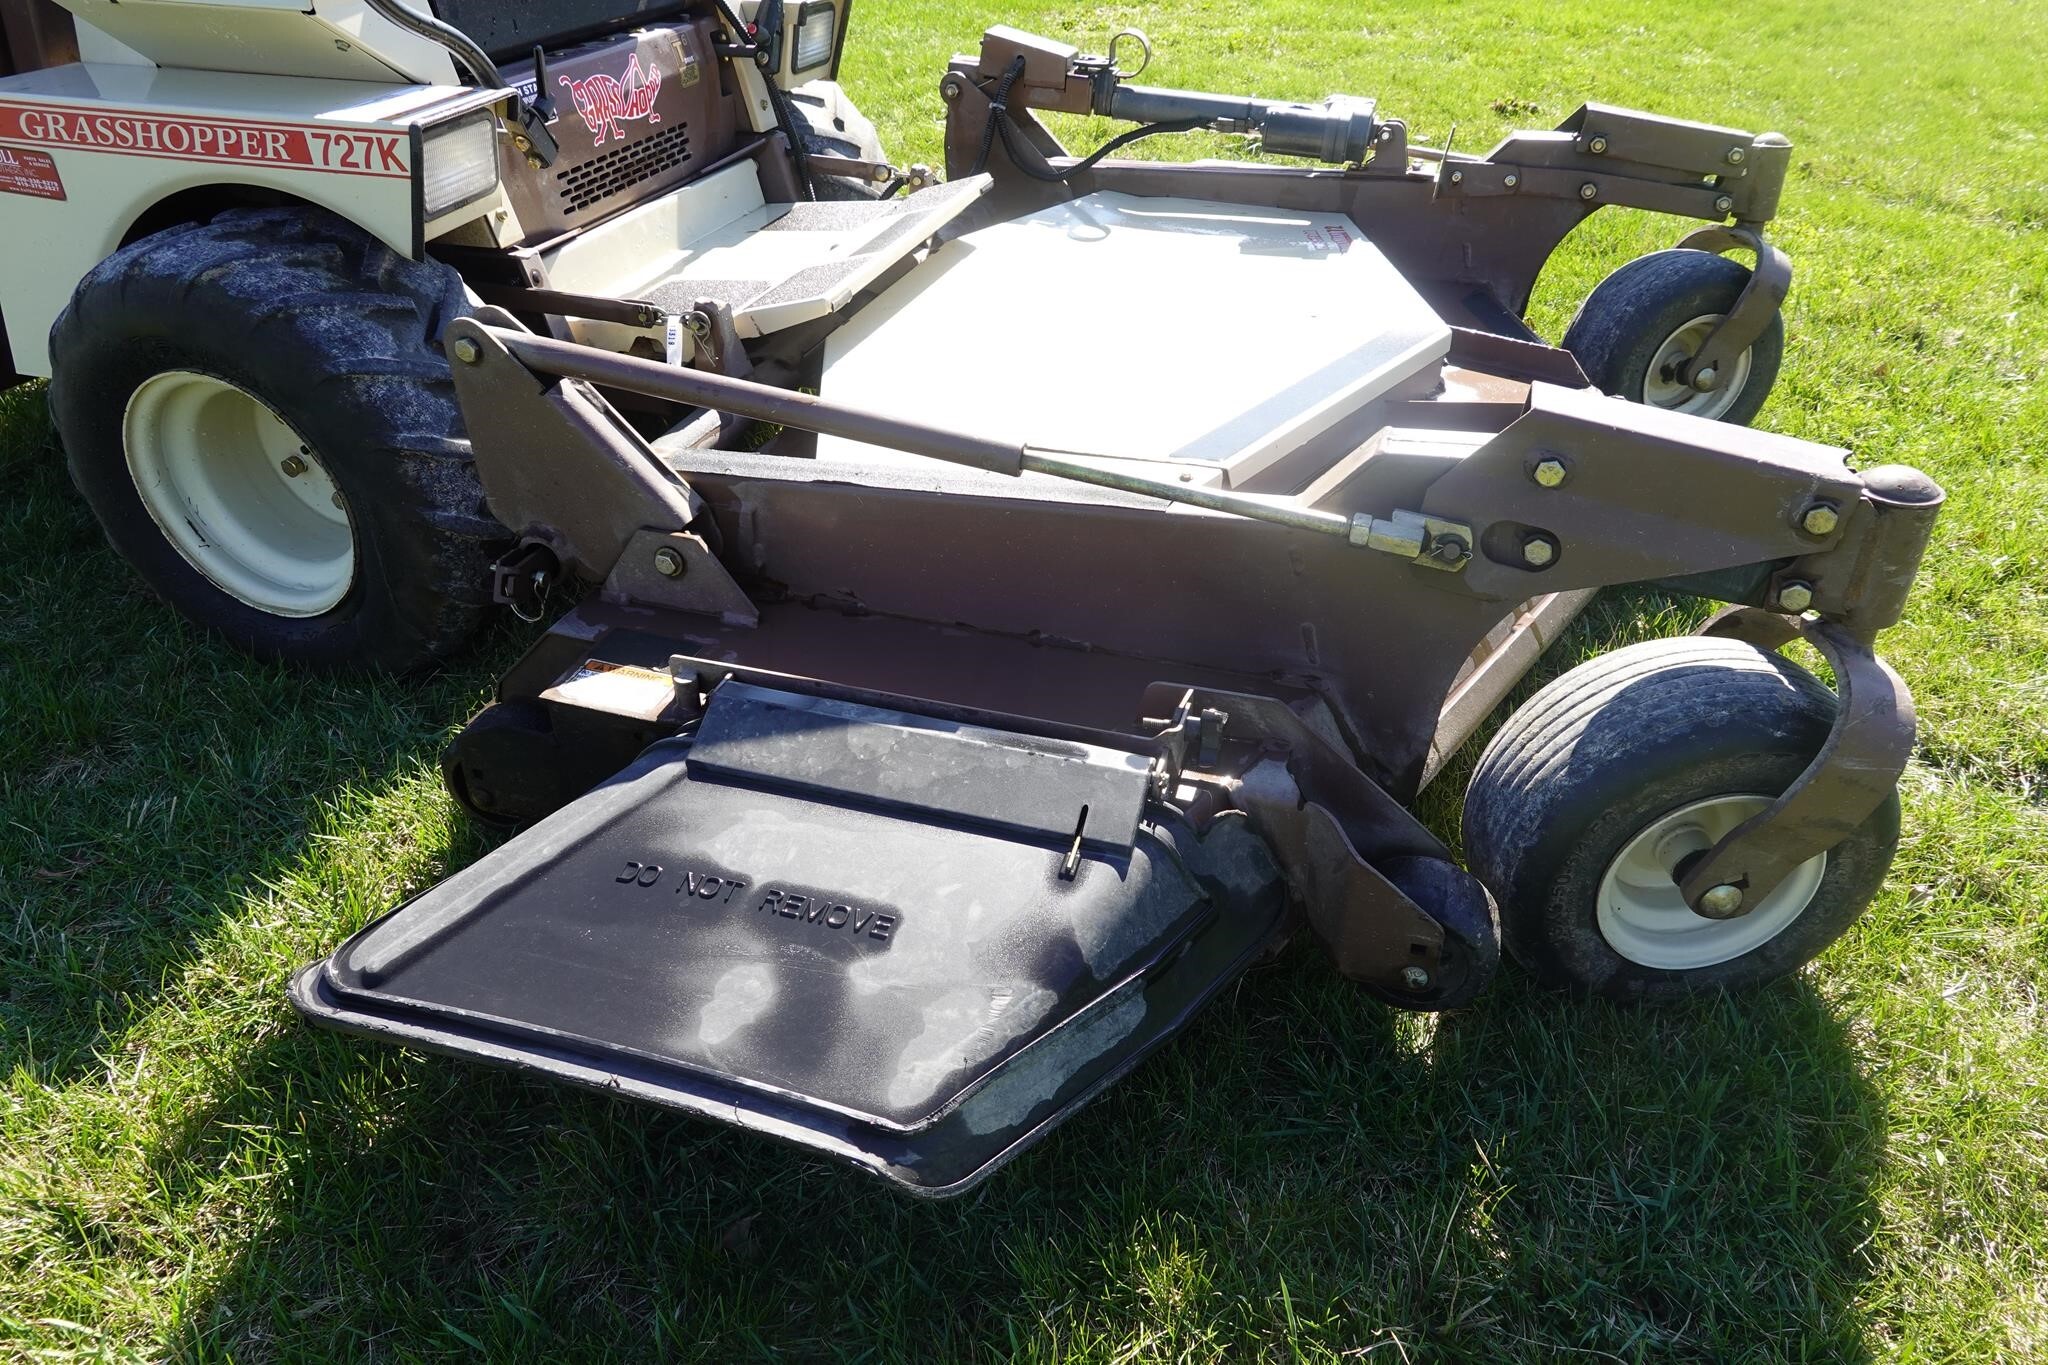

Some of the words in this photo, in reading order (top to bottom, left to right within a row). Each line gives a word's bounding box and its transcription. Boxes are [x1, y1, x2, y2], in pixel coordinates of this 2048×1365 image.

[19, 111, 291, 160] GRASSHOPPER
[310, 132, 409, 172] 727K
[607, 663, 664, 681] WARNING
[616, 861, 663, 887] DO
[675, 871, 746, 903] NOT
[758, 889, 896, 940] REMOVE
